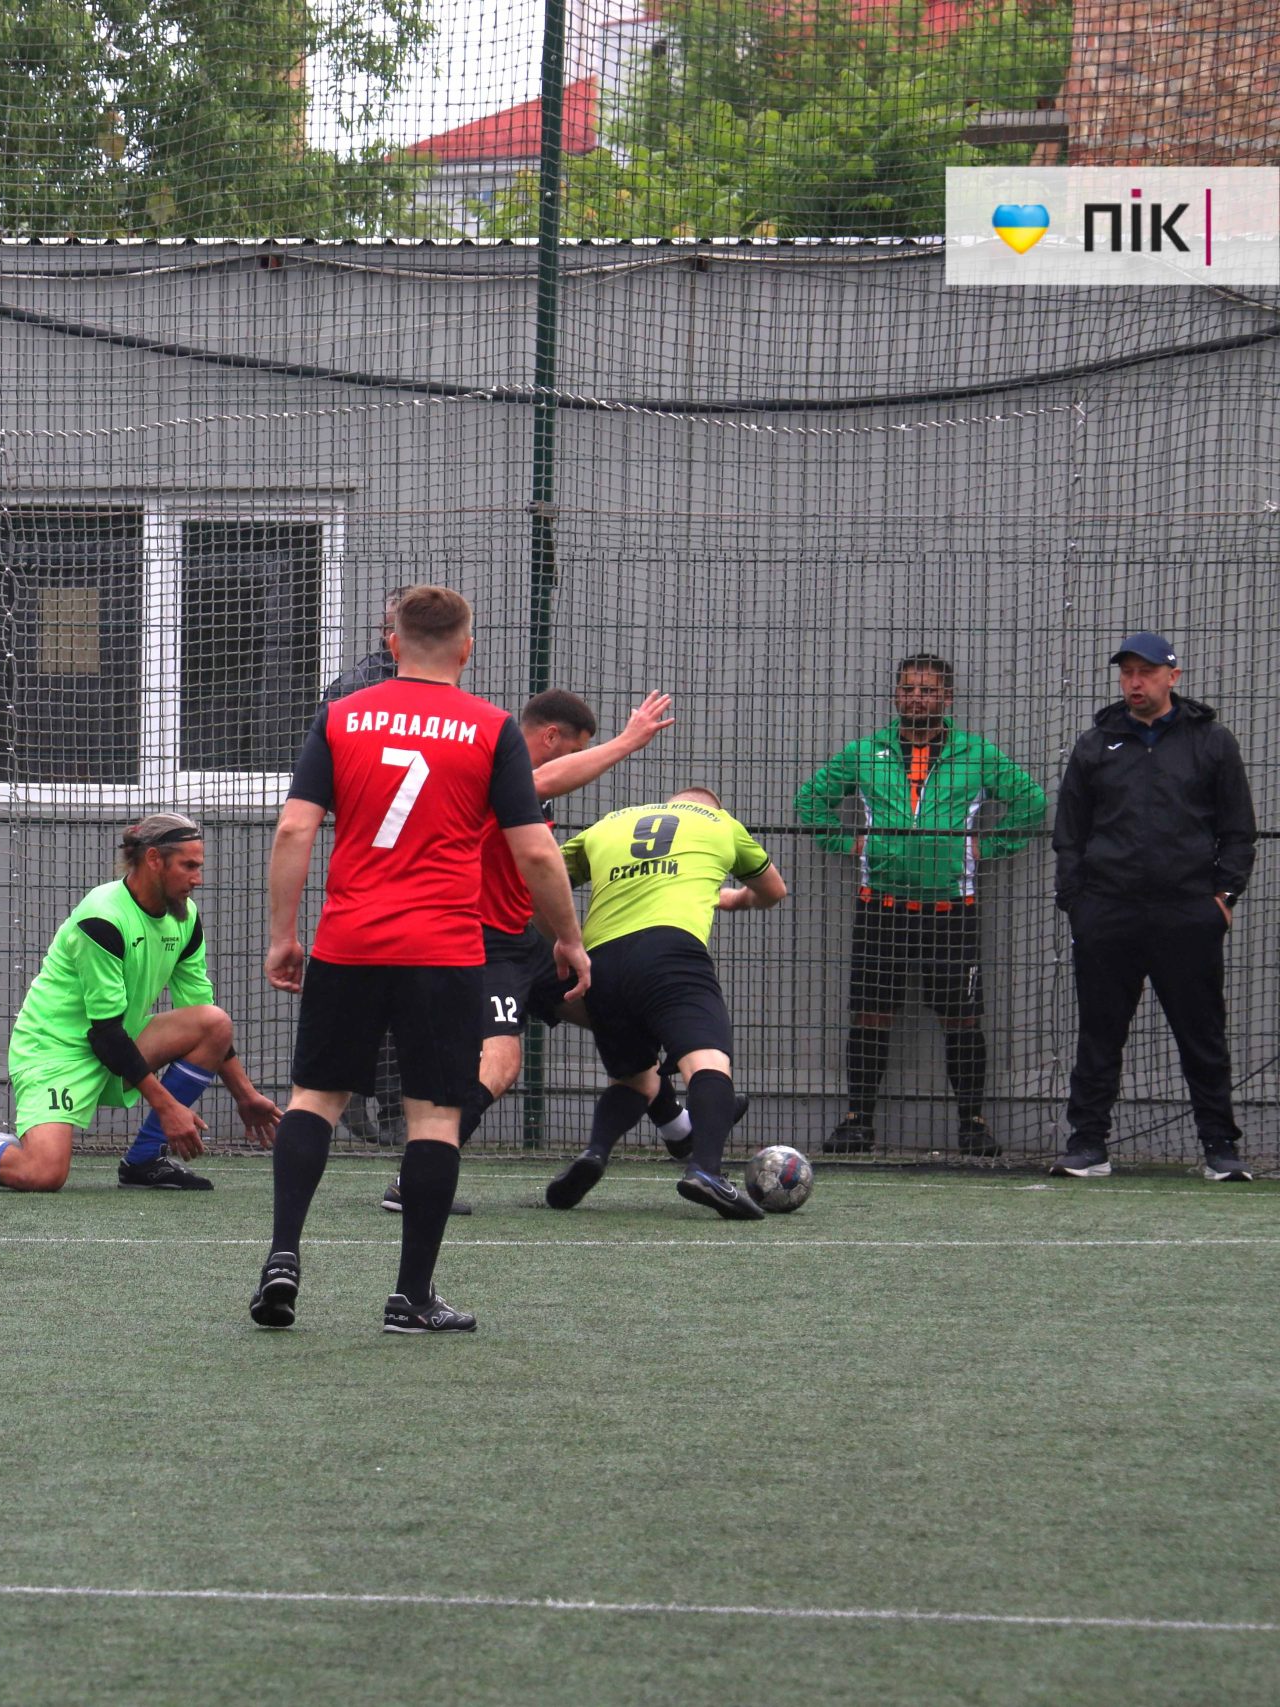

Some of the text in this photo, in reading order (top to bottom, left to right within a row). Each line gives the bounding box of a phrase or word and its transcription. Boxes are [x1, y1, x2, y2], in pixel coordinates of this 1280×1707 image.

[346, 711, 478, 744] БАРДАДИМ
[371, 747, 430, 849] 7
[630, 814, 680, 859] 9
[490, 995, 518, 1024] 12
[47, 1087, 74, 1112] 16
